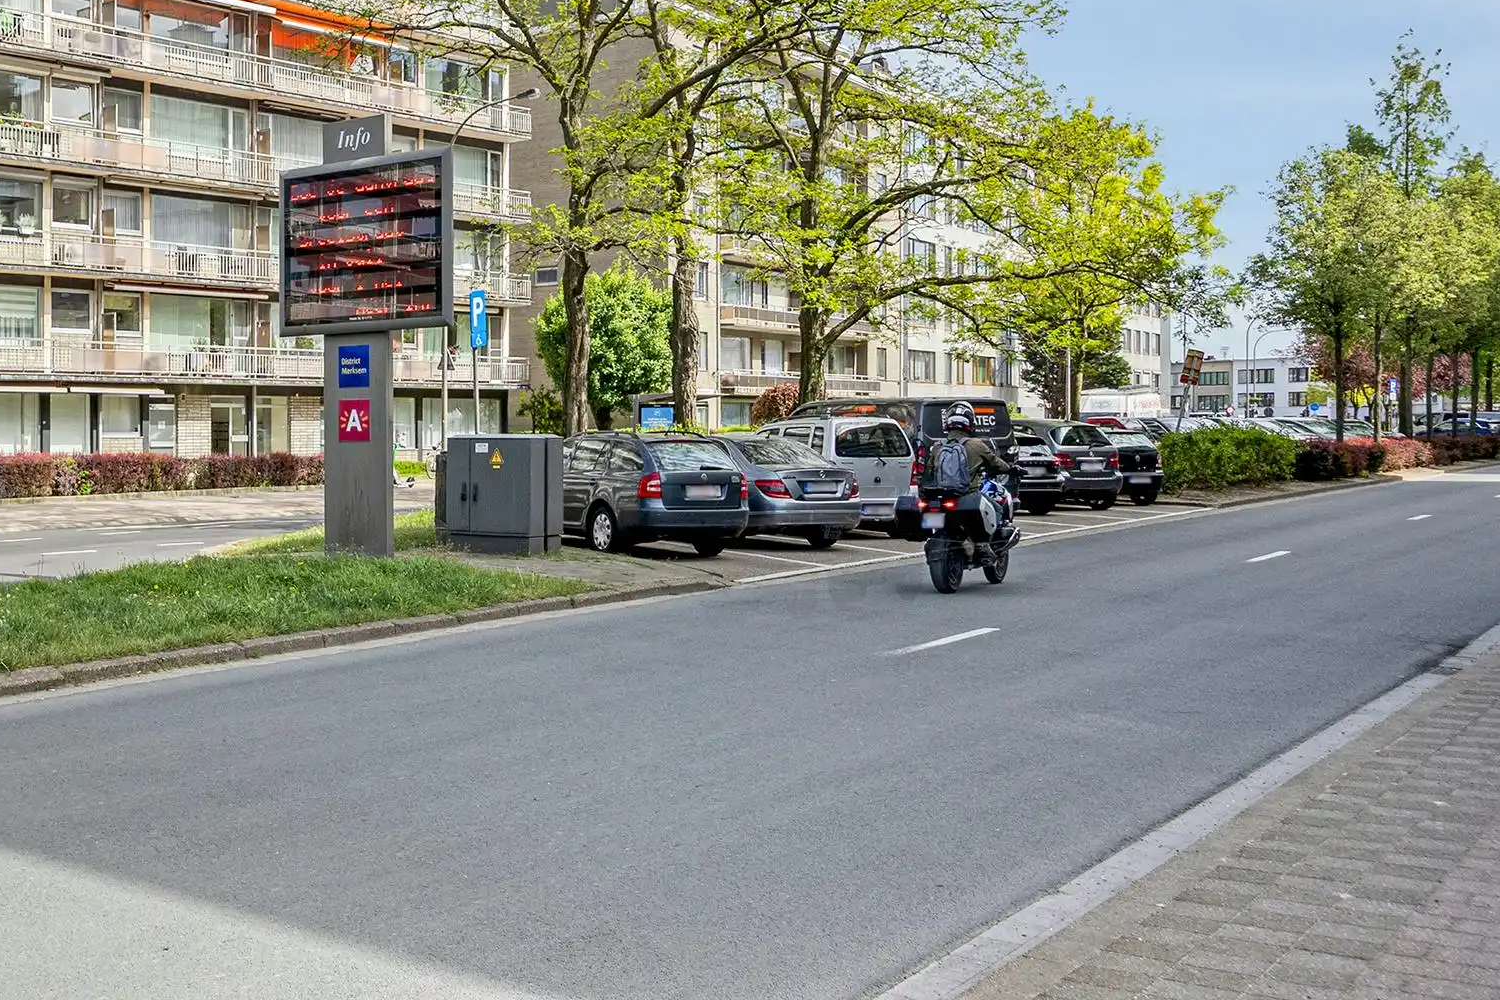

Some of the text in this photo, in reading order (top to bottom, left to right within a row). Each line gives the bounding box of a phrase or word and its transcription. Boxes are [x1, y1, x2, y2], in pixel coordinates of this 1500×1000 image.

[337, 127, 371, 150] Info
[473, 297, 484, 327] P
[346, 408, 362, 432] A
